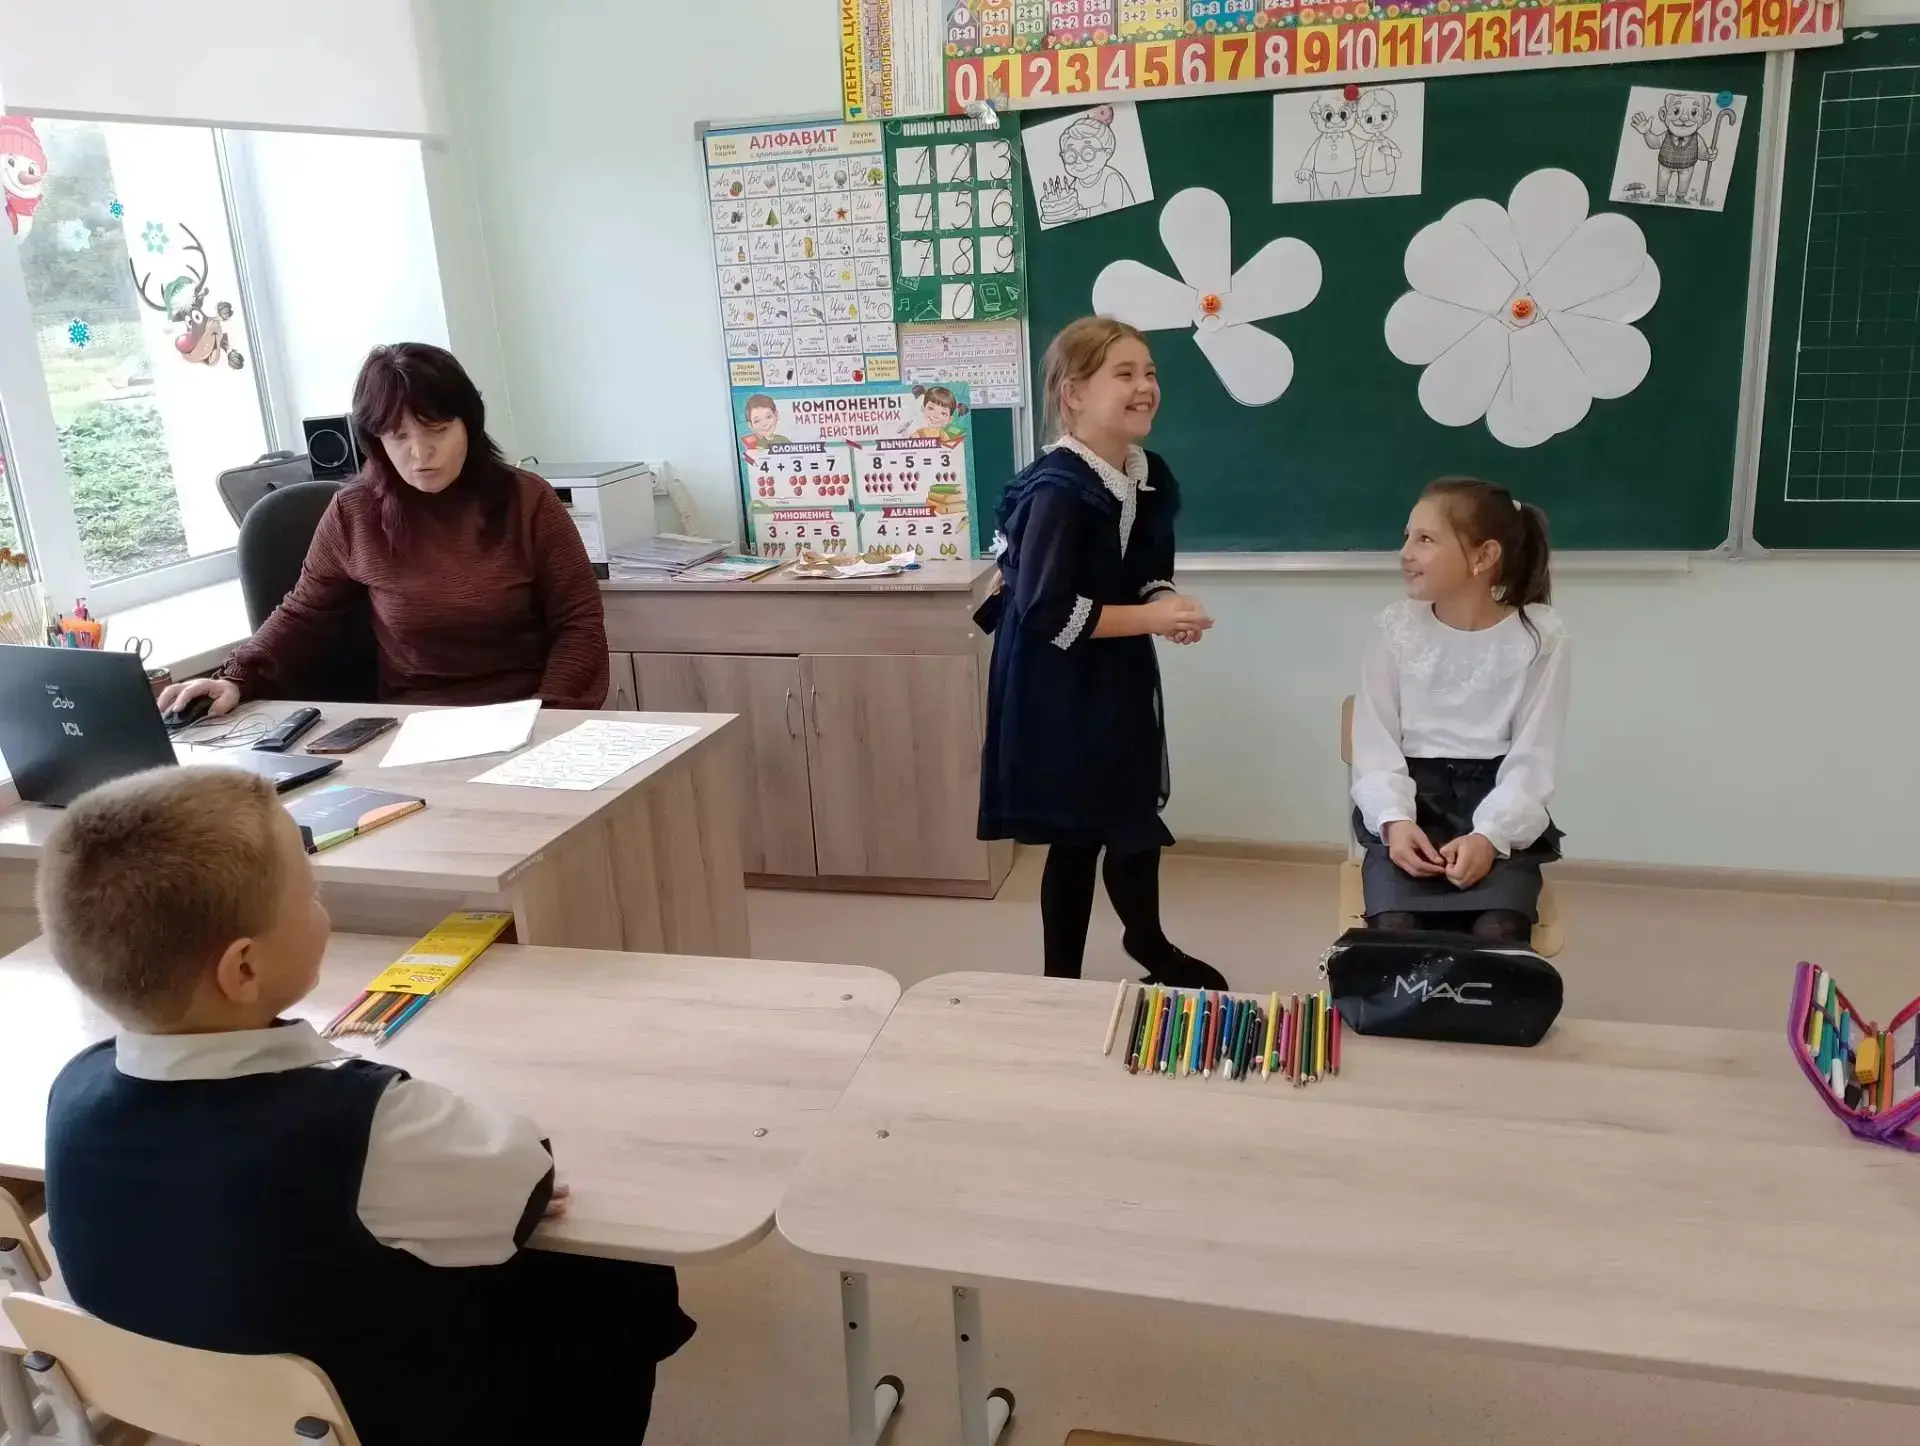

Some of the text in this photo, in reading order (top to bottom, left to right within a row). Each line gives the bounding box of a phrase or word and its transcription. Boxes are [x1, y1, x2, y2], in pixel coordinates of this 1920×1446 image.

[1019, 6, 1040, 18] 2+1
[1055, 3, 1077, 14] 1+3
[1155, 7, 1178, 19] 5+0
[1195, 3, 1217, 15] 3+3
[1054, 17, 1077, 29] 2+2
[1123, 10, 1146, 22] 3+2
[1019, 21, 1041, 33] 3+0
[955, 0, 1840, 108] 0 1 2 3 4 5 6 7 8 9 10 11 12 13 14 15 16 17 18 19 20
[844, 43, 858, 104] ЛЕНТА
[903, 121, 935, 136] ПИШИ
[750, 128, 838, 149] АЛФАВИТ
[915, 139, 1012, 185] 1 2 3
[915, 187, 1013, 231] 4 5 6
[914, 234, 1015, 276] 7 8 9
[952, 282, 975, 320] 0
[792, 396, 902, 413] КОМПОНЕНТЫ
[795, 410, 901, 425] МАТЕМАТИЧЕСКИХ
[772, 443, 822, 453] СЛОЖЕНИЕ
[880, 439, 937, 449] ВЫЧИТАНИЕ
[760, 461, 770, 473] 4
[793, 460, 802, 472] 3
[826, 459, 836, 471] 7
[873, 456, 882, 469] 8
[905, 455, 914, 469] 5
[941, 454, 950, 467] 3
[774, 511, 831, 520] УМНОЖЕНИЕ
[890, 508, 931, 517] ДЕЛЕНИЕ
[768, 526, 777, 538] 3
[796, 525, 806, 538] 2
[830, 525, 840, 537] 6
[877, 524, 887, 536] 4
[907, 523, 917, 536] 2
[942, 522, 952, 535] 2
